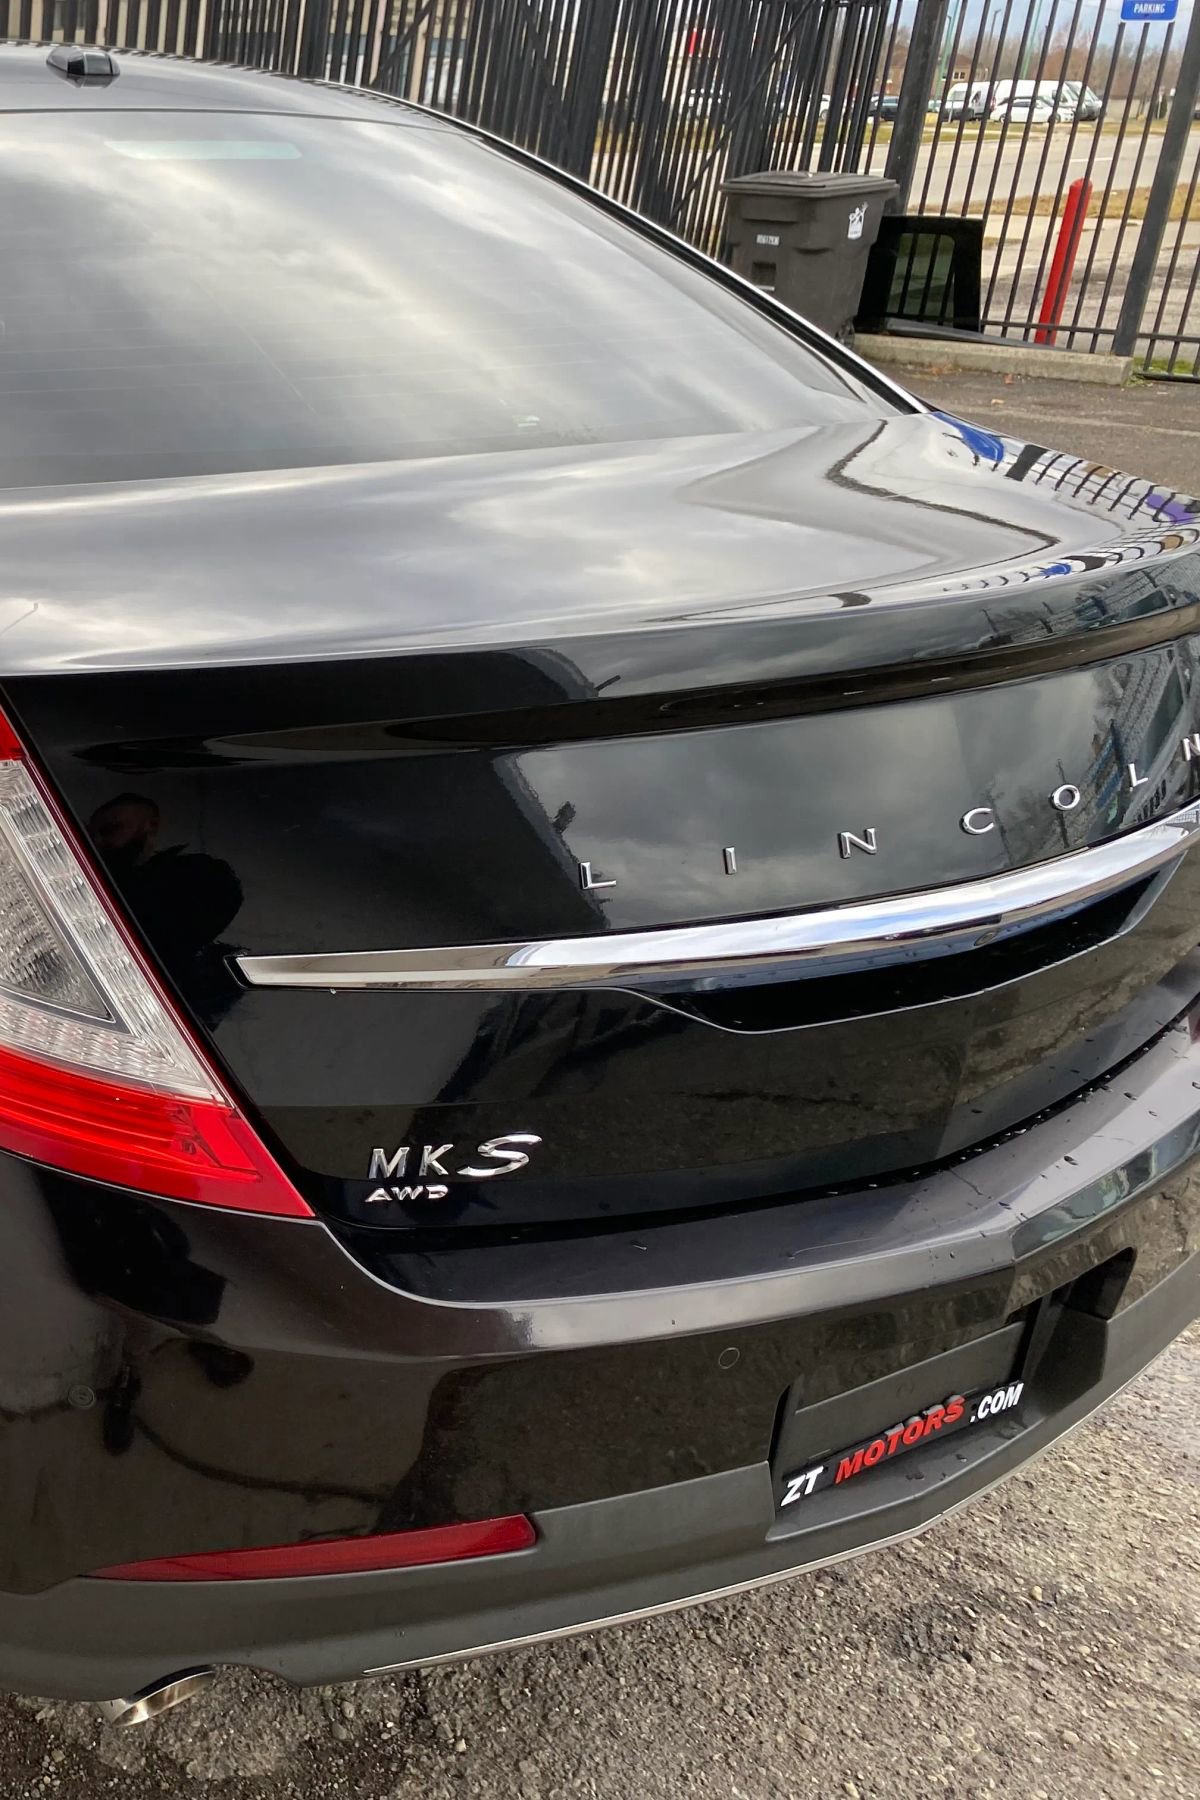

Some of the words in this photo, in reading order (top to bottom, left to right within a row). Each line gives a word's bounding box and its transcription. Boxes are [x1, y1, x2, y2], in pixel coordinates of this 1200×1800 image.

[1133, 3, 1166, 14] PARKING
[579, 732, 1200, 891] LINCOLN
[368, 1133, 543, 1179] MKS
[364, 1184, 450, 1203] AWD
[780, 1465, 825, 1508] ZT
[835, 1394, 967, 1485] MOTORS
[969, 1382, 1025, 1424] .COM
